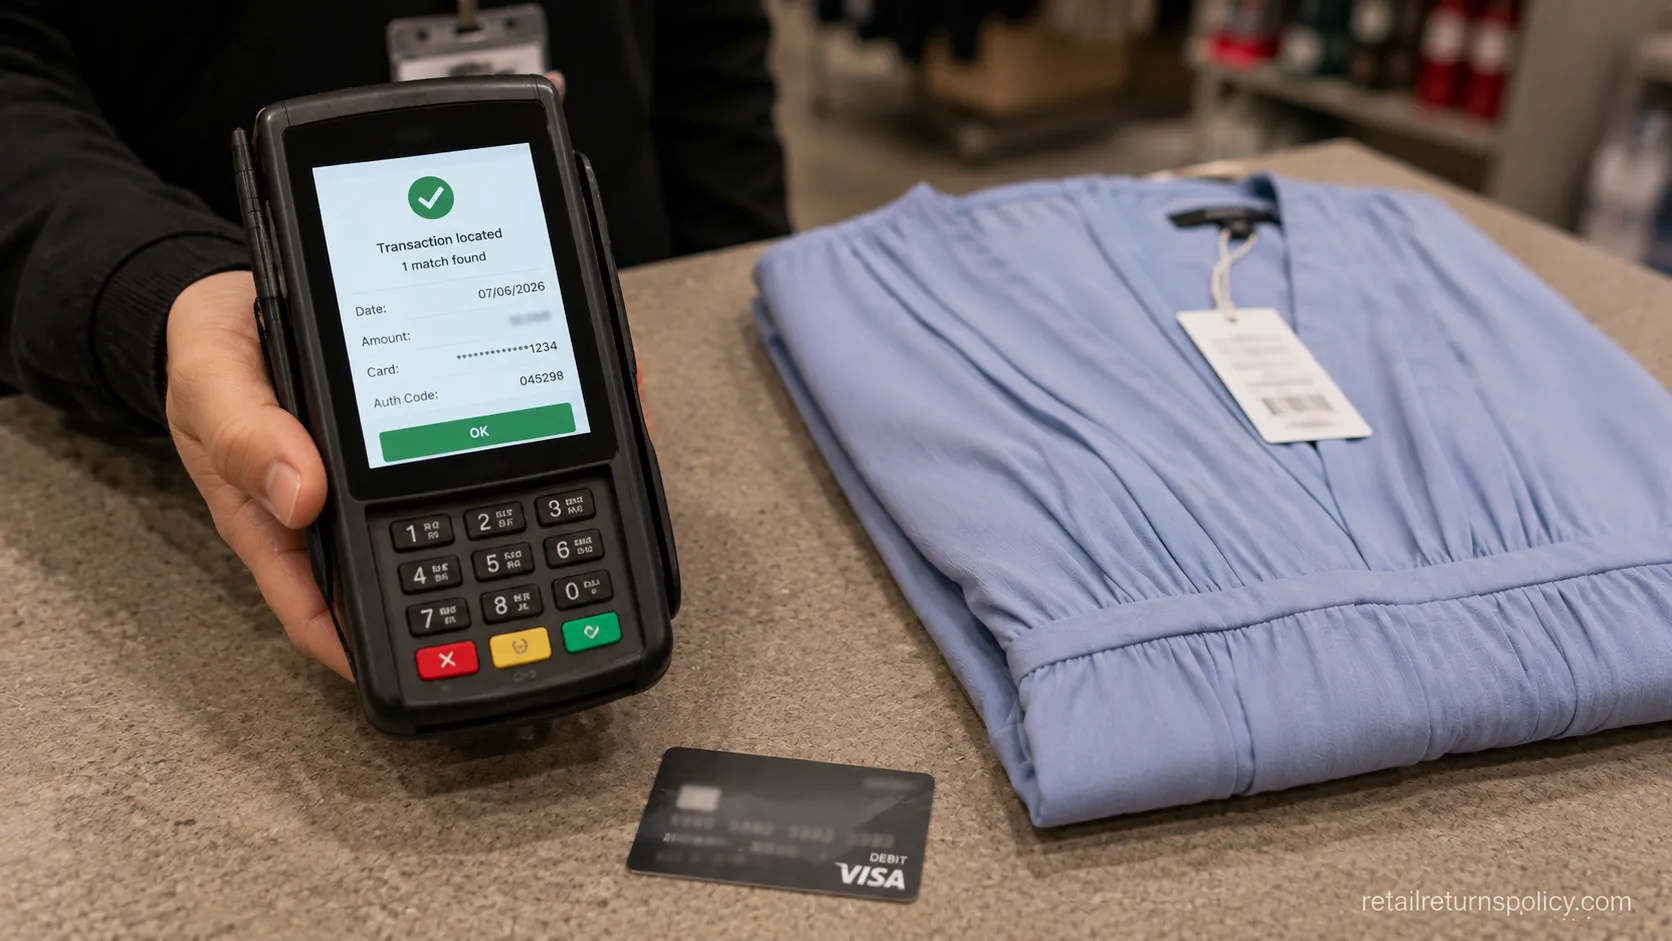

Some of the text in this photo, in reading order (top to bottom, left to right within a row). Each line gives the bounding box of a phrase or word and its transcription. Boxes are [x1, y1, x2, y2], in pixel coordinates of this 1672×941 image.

[376, 228, 503, 254] Transaction located
[402, 252, 486, 271] 1 match found
[355, 281, 545, 317] Date: 07/06/2026
[361, 332, 410, 347] Amount:
[367, 364, 399, 377] Card:
[373, 371, 564, 408] Auth Code: 045298
[469, 425, 489, 439] OK
[548, 500, 562, 517] 3
[478, 513, 491, 531] 2
[406, 525, 416, 542] 1
[556, 541, 569, 558] 6
[486, 554, 499, 572] 5
[413, 567, 426, 584] 4
[565, 582, 579, 600] 0
[494, 596, 508, 614] 8
[421, 609, 433, 628] 7
[870, 852, 907, 865] DEBIT
[835, 862, 905, 890] VISA
